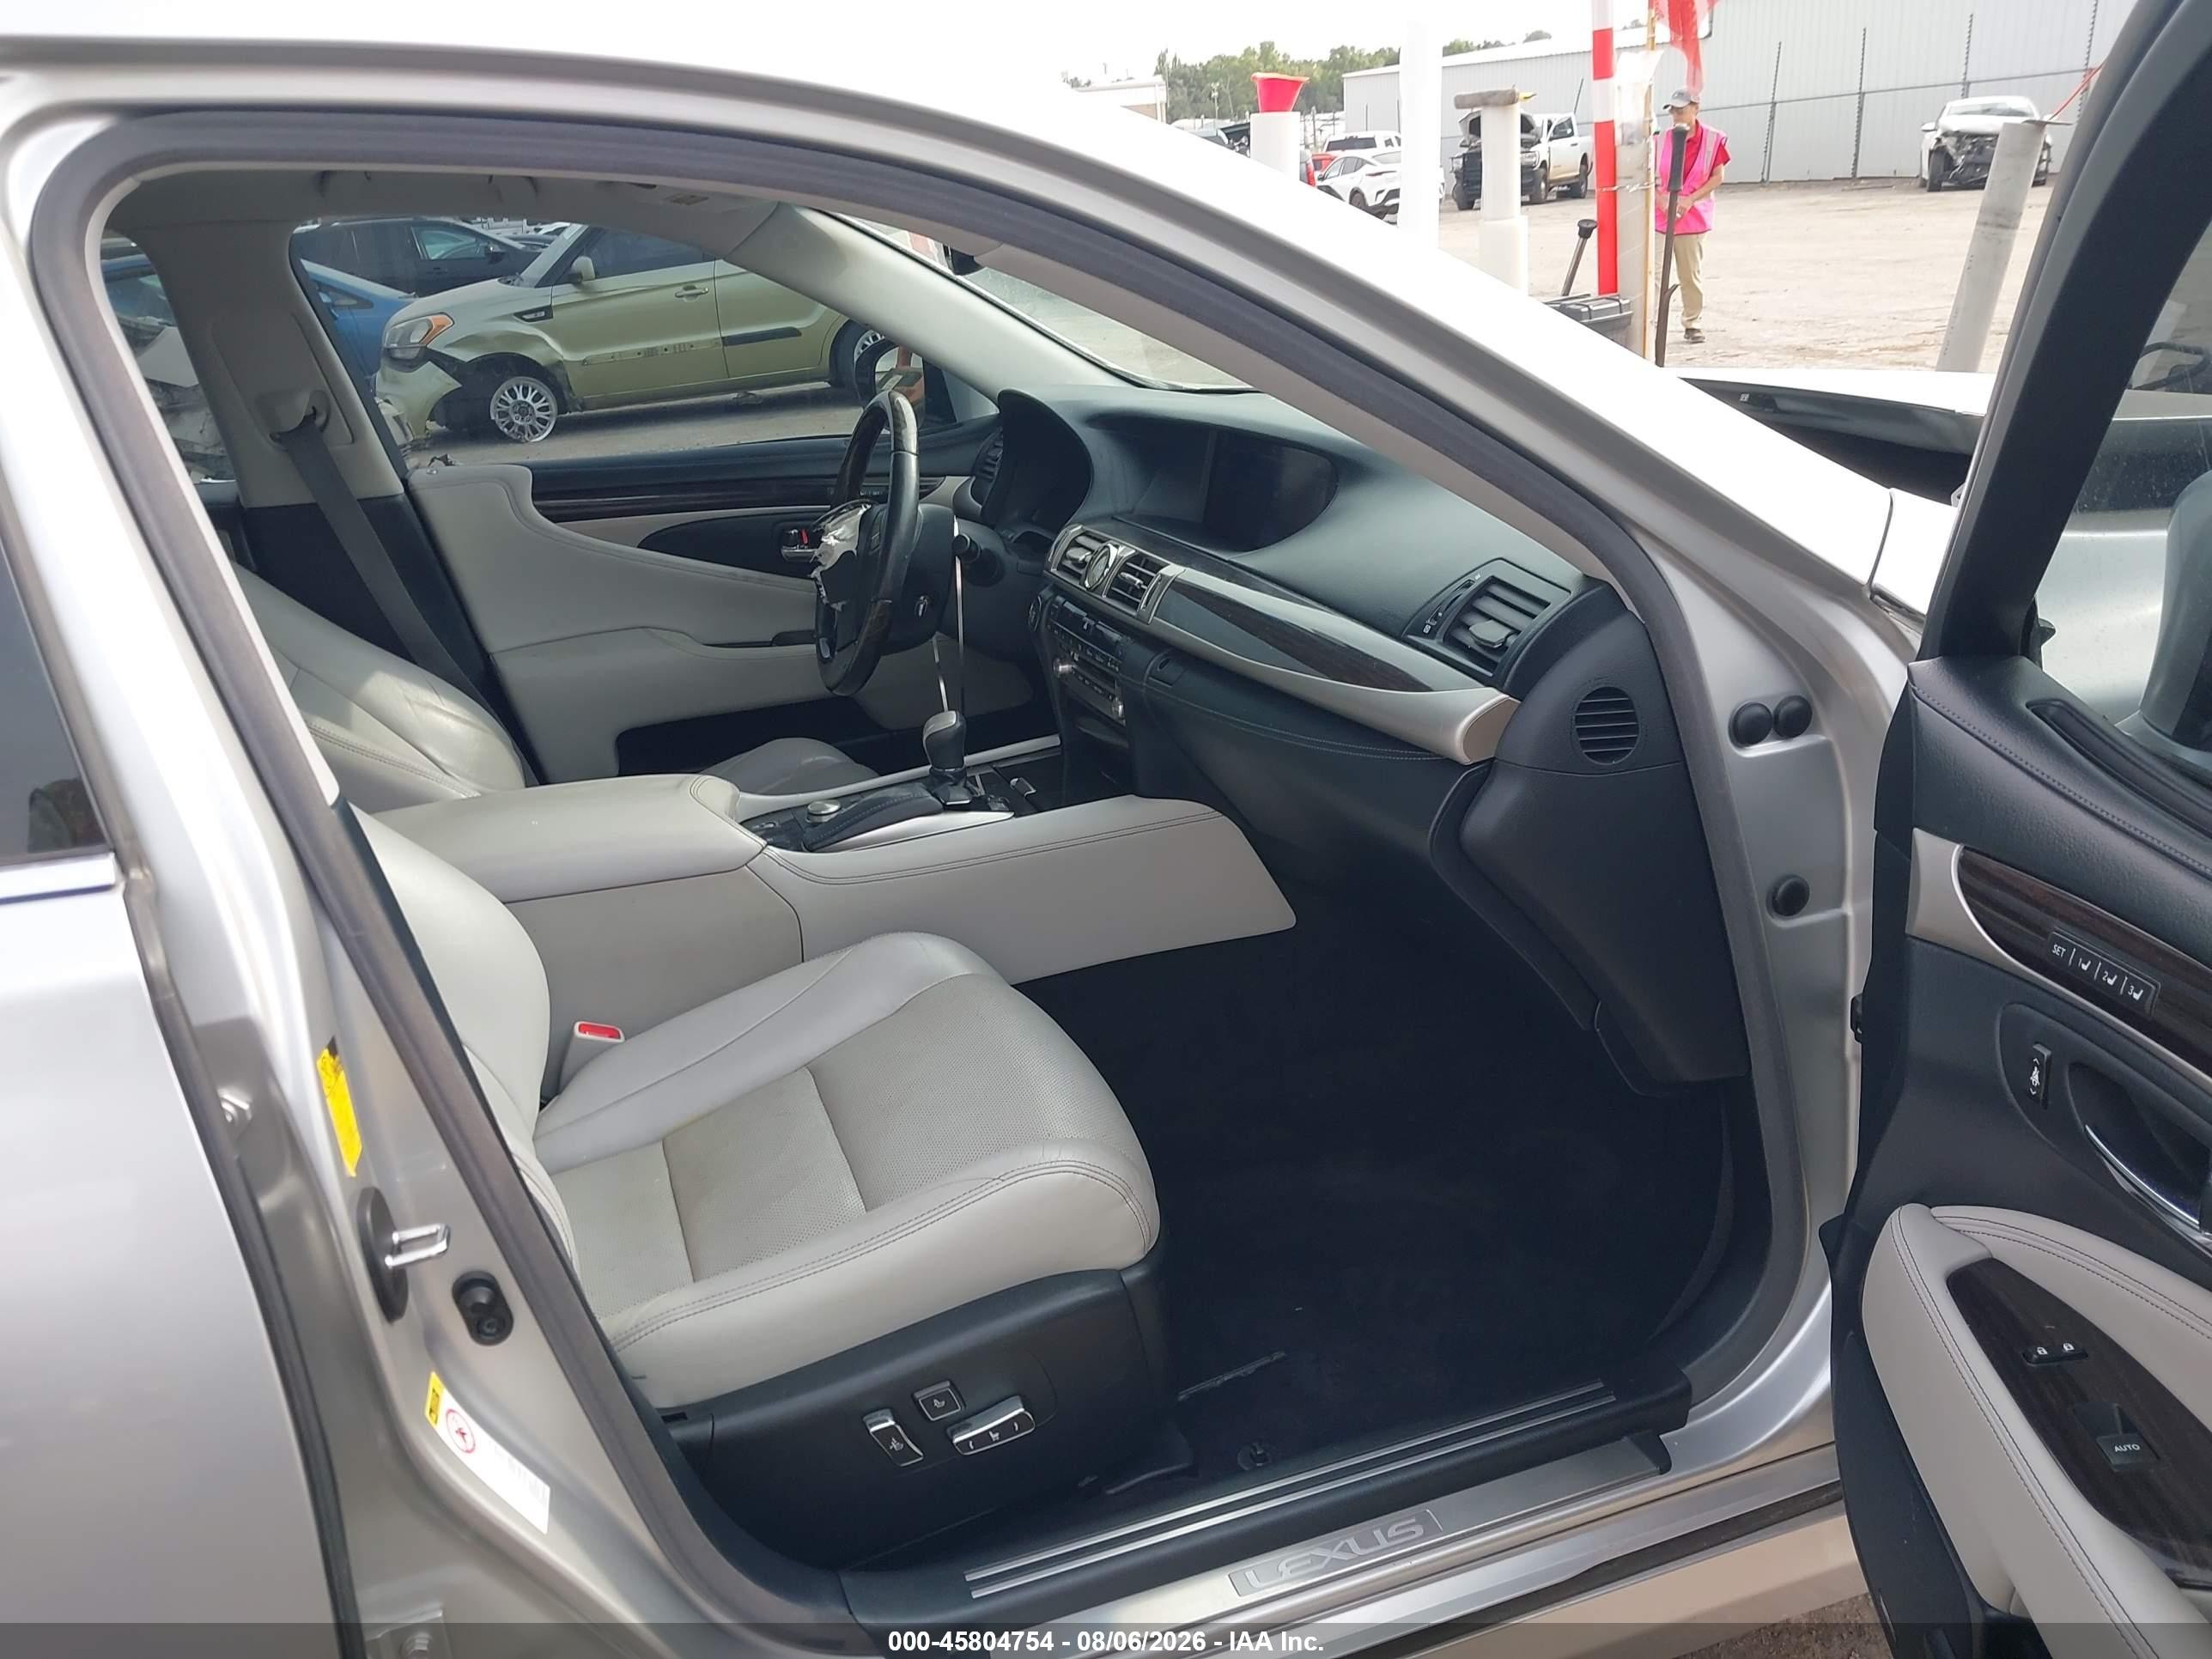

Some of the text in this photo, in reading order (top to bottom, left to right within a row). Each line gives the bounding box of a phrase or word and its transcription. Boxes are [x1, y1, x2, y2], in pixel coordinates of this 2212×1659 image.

[2051, 943, 2067, 958] SET
[2102, 971, 2109, 981] 2
[2128, 985, 2135, 995] 3
[2113, 1443, 2141, 1453] AUTO
[1243, 1516, 1425, 1589] LEXUS
